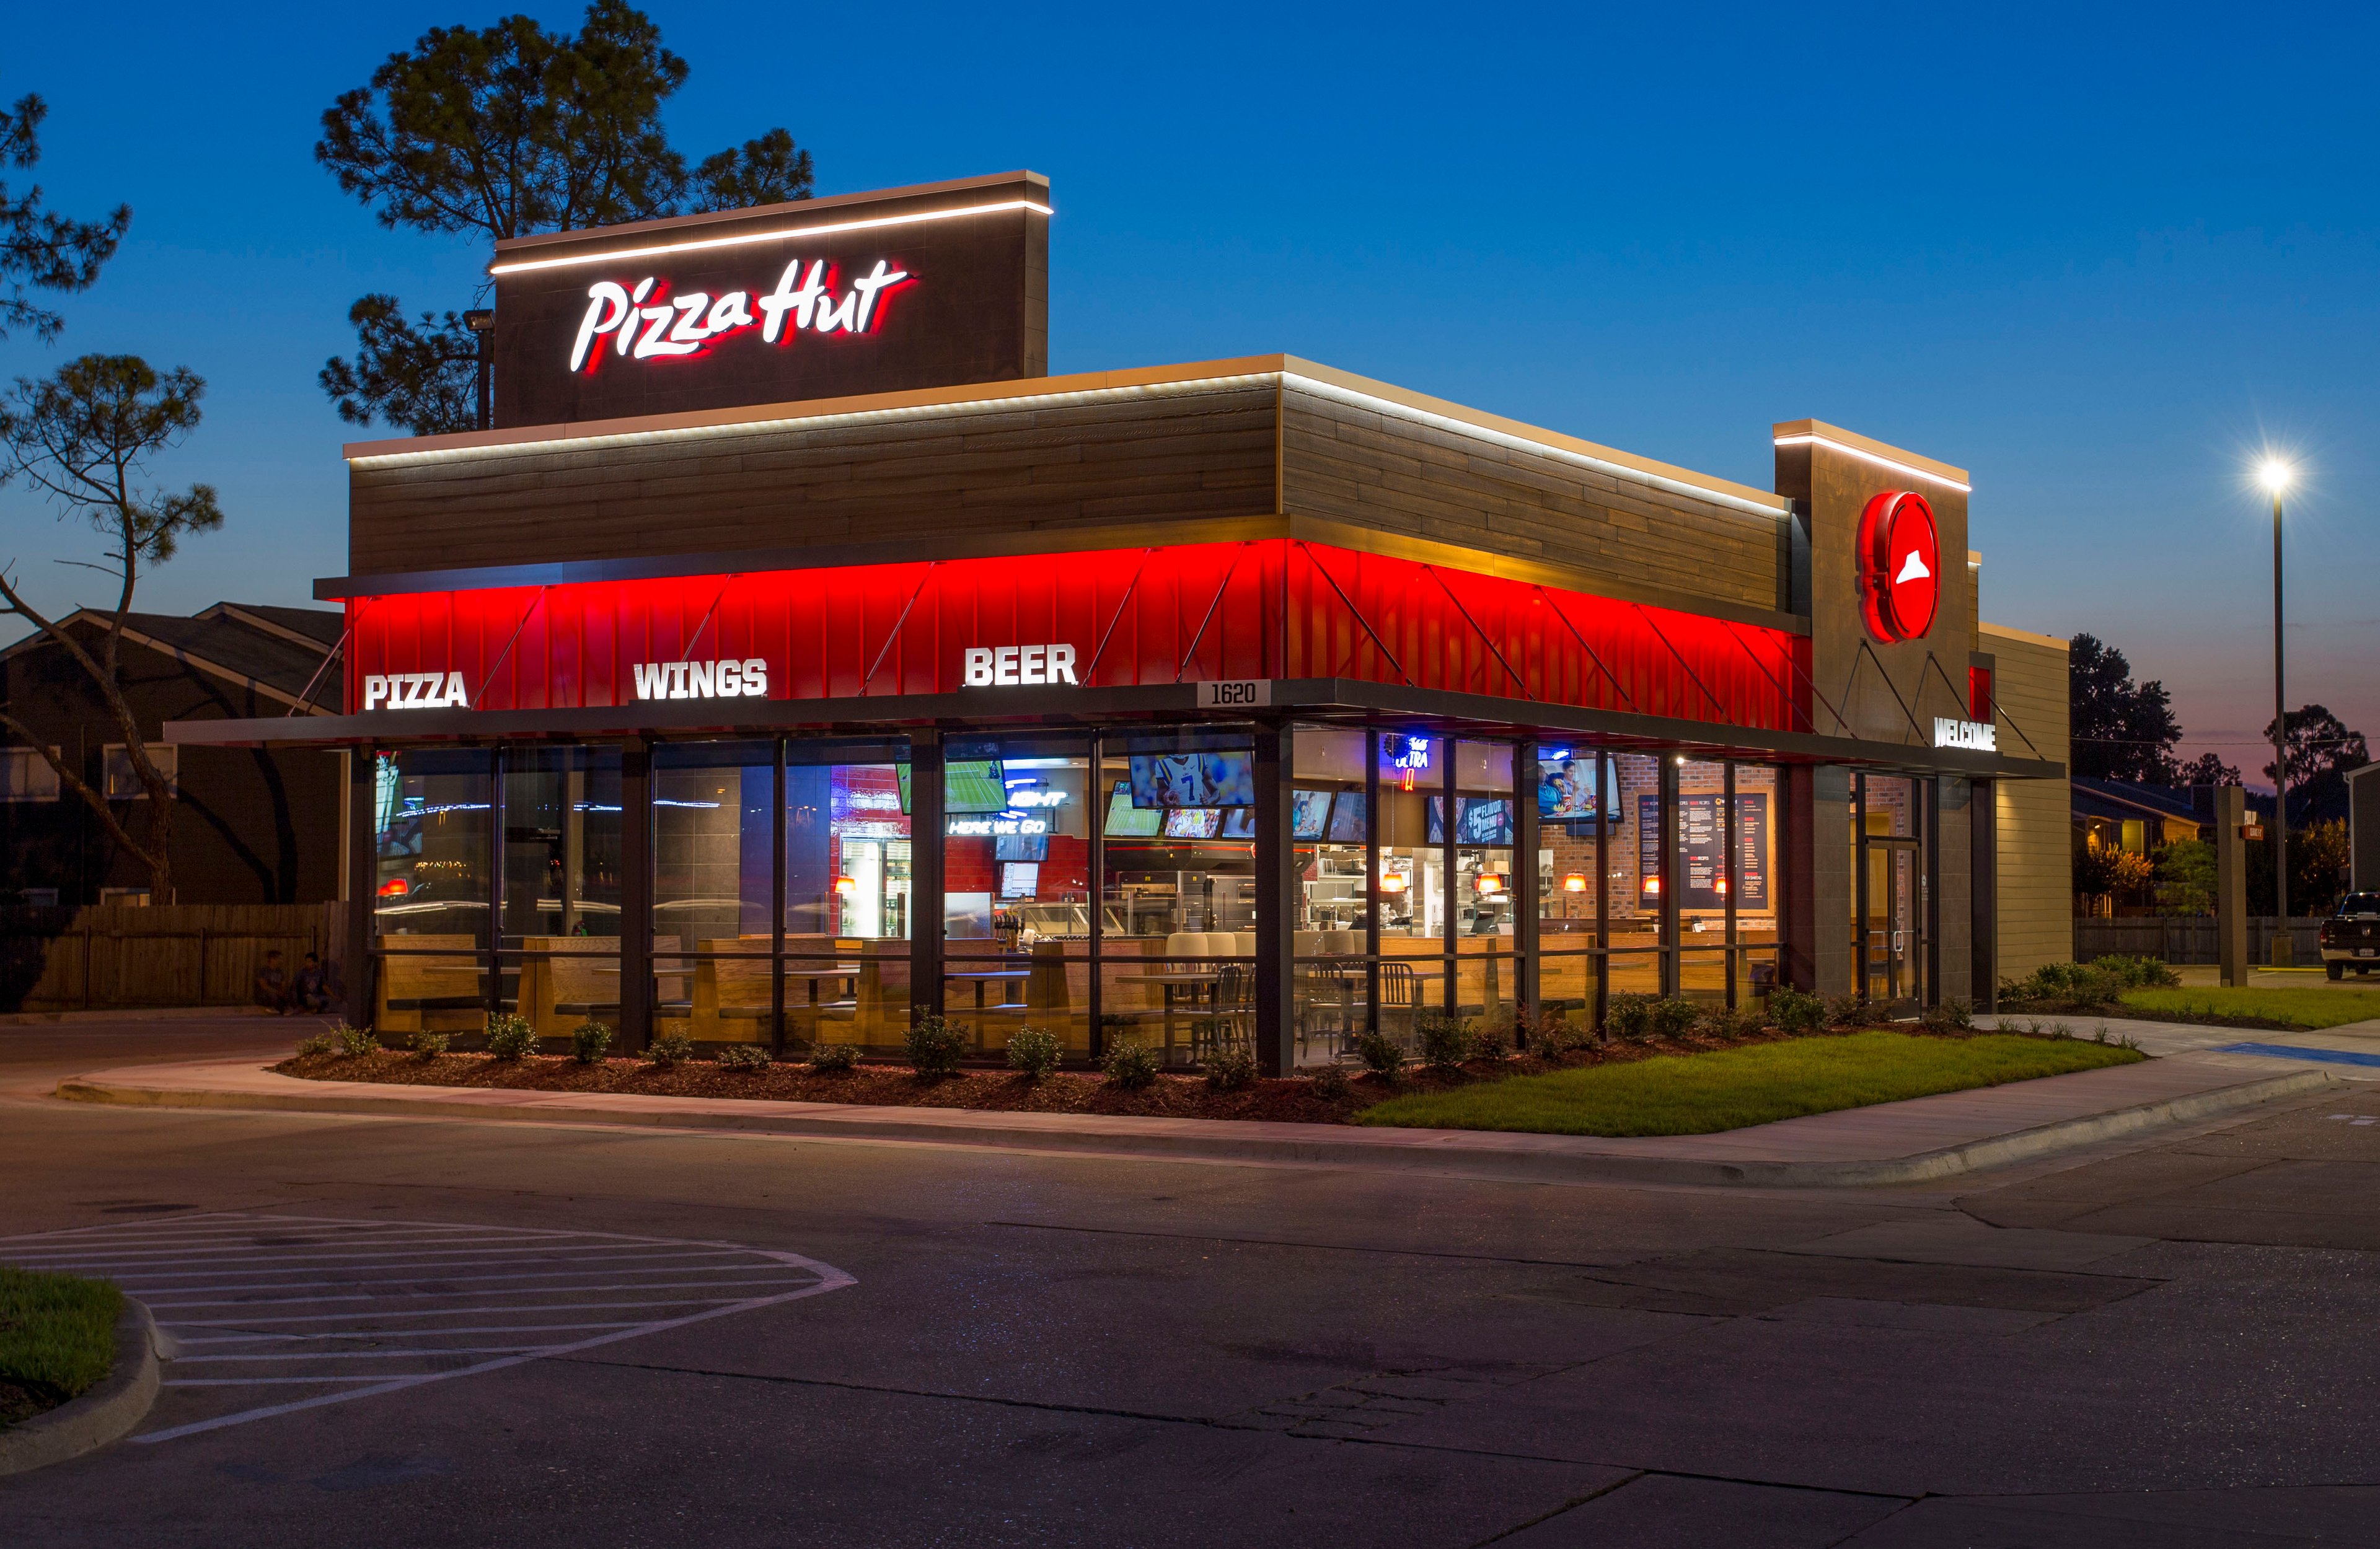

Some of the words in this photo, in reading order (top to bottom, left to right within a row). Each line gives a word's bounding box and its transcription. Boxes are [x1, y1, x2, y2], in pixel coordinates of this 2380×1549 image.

[570, 277, 752, 372] Pizza
[759, 259, 908, 343] Hut
[633, 659, 767, 700] WINGS
[965, 643, 1075, 686] BEER
[366, 672, 468, 710] PIZZA
[1212, 683, 1256, 704] 1620
[1934, 717, 1996, 752] WELCOME
[1181, 775, 1196, 801] 7
[949, 821, 992, 834] HERE
[994, 821, 1019, 833] WE
[1021, 820, 1046, 833] GO
